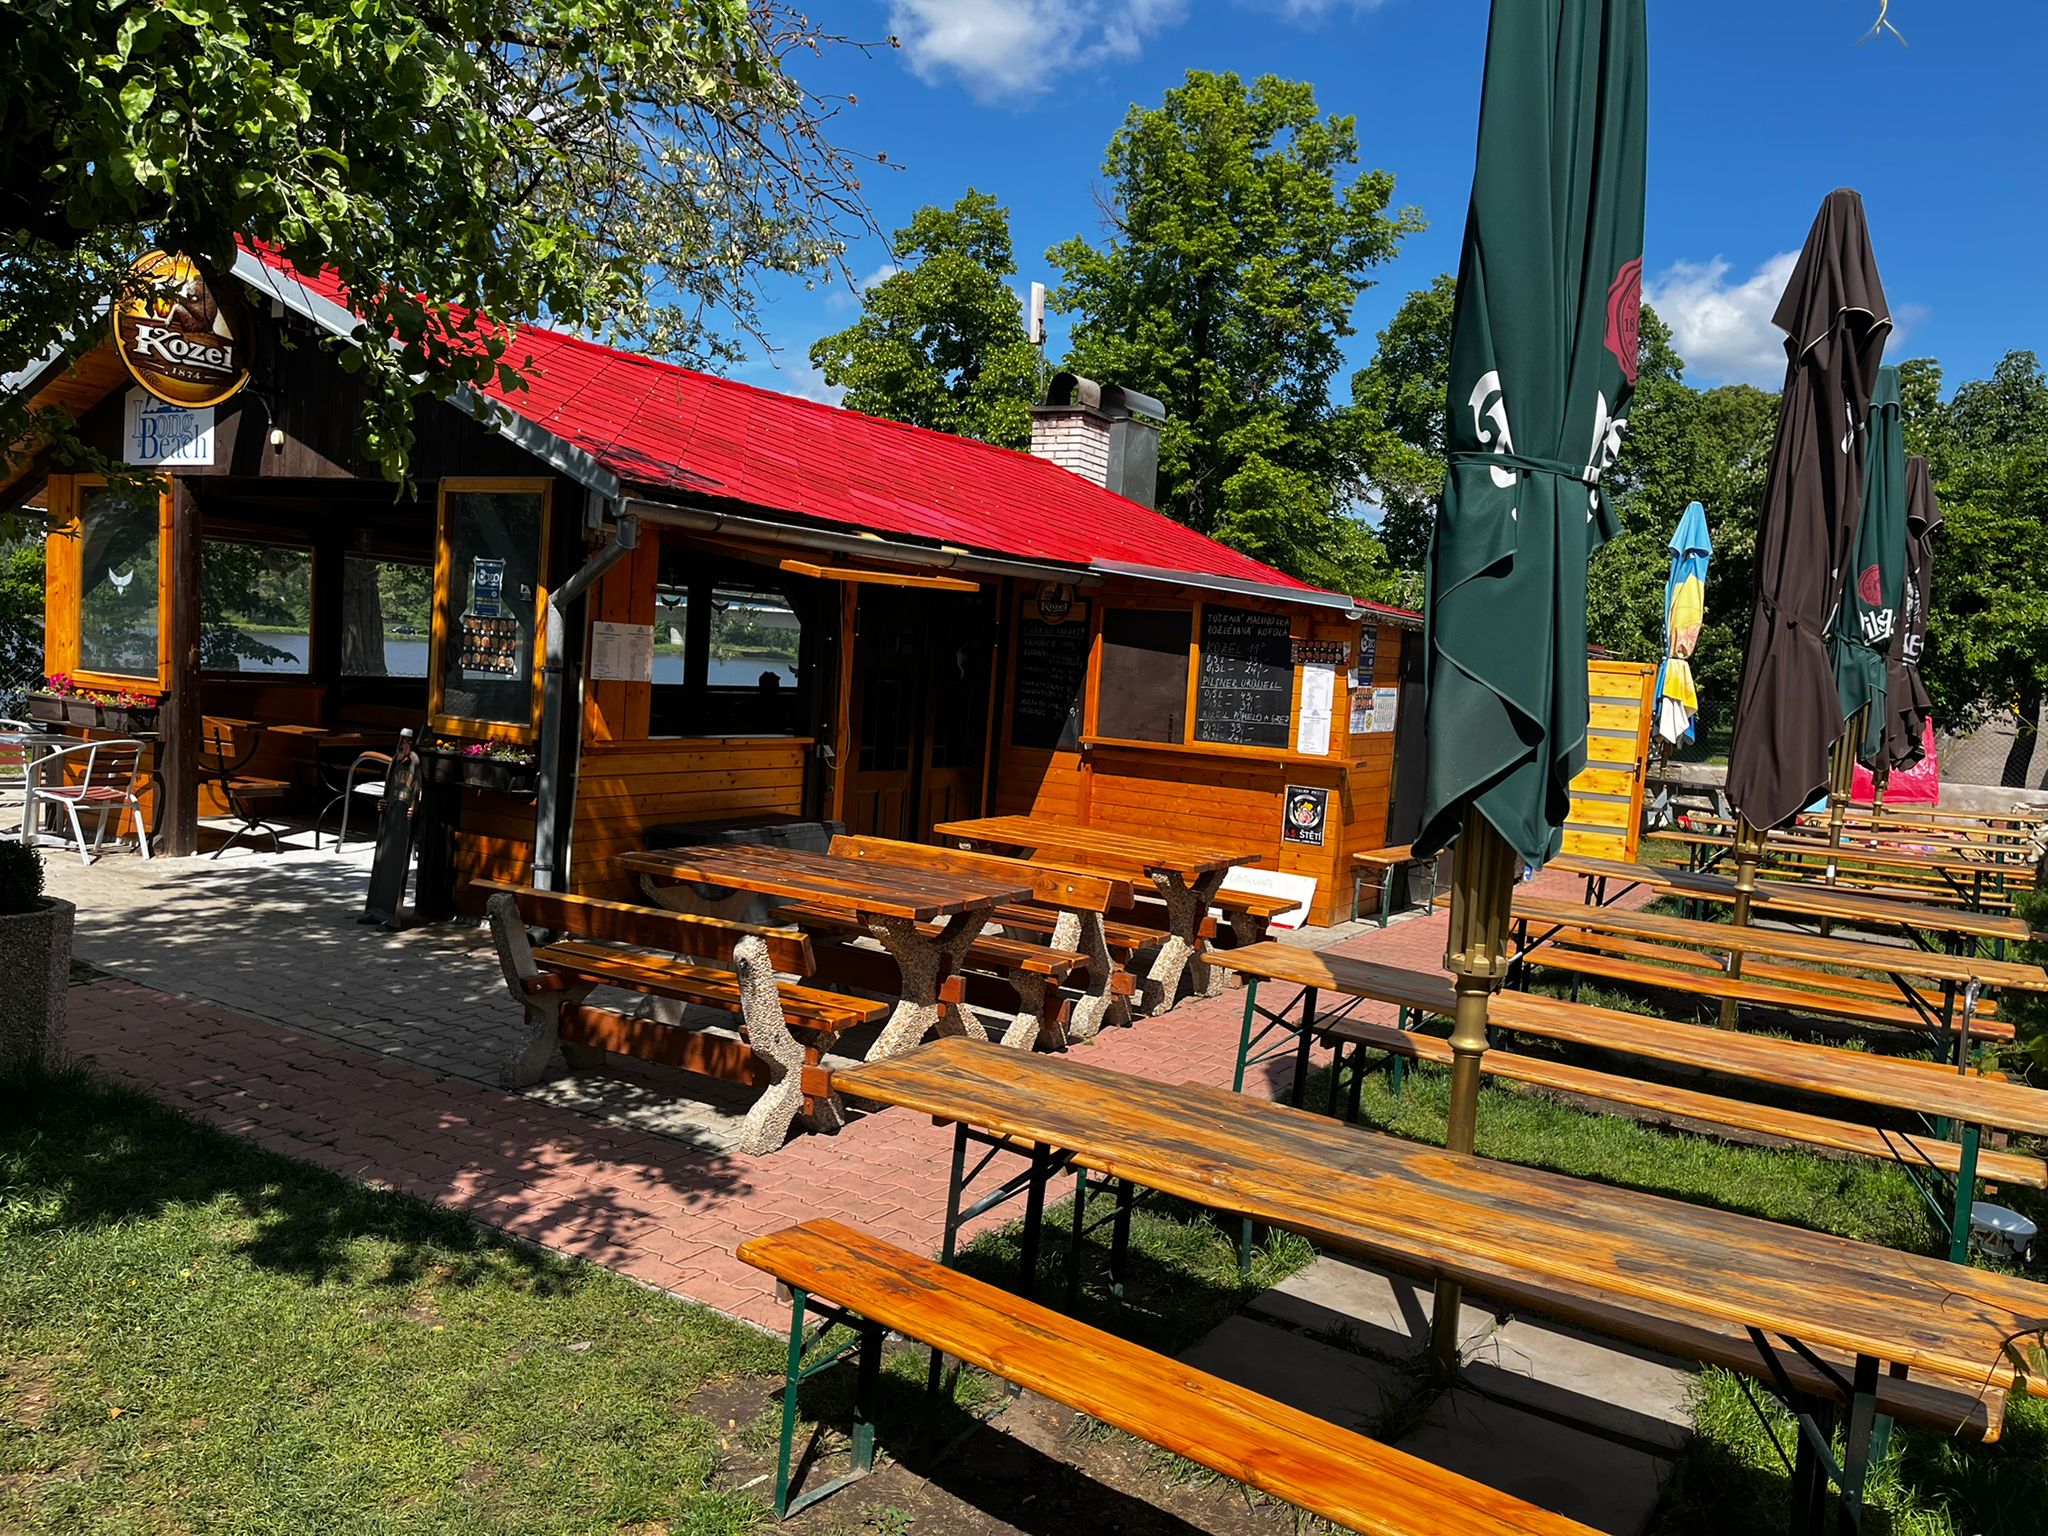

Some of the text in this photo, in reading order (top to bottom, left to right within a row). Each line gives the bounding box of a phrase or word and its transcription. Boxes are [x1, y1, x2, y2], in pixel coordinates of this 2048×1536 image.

[133, 323, 232, 369] Kozel
[171, 367, 200, 380] 1874
[132, 400, 194, 444] Long
[139, 417, 207, 459] Beach
[1202, 676, 1238, 688] PILSNER
[1299, 829, 1322, 841] ŠTĚTÍ
